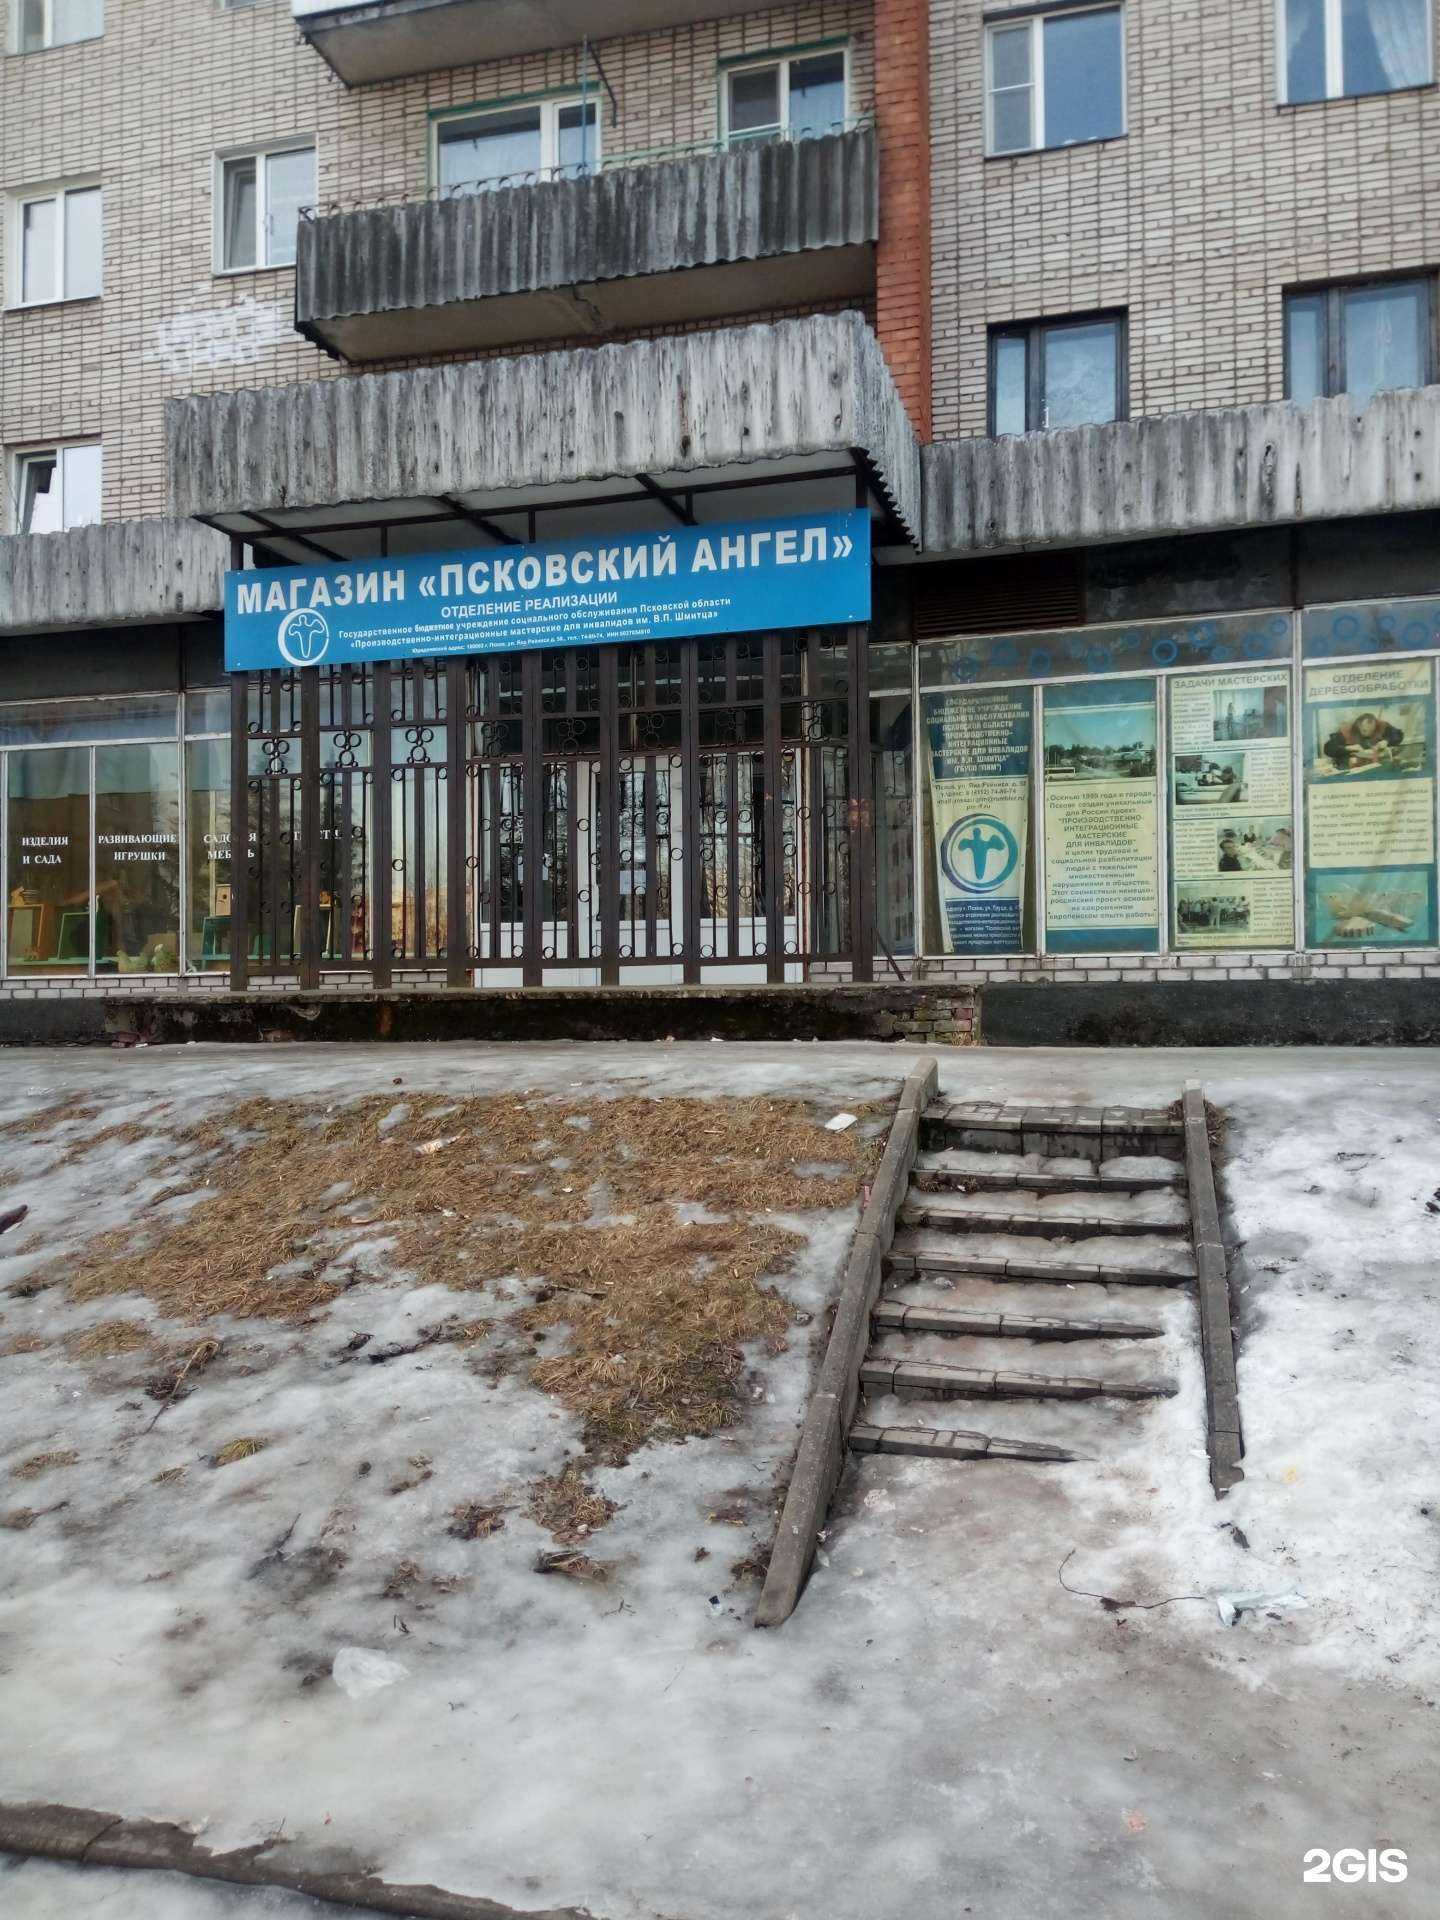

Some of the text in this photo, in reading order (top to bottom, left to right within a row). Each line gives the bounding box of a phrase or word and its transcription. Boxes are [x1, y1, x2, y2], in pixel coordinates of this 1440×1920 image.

[237, 526, 853, 615] МАГАЗИН «ПСКОВСКИЙ АНГЕЛ»
[441, 591, 618, 619] ОТДЕЛЕНИЕ РЕАЛИЗАЦИИ
[338, 597, 731, 640] Государственное бюджетное учреждение социального обслуживания Псковской области
[350, 610, 718, 649] «Производственно-интеграционные мастерские для инвалидов им. В.П. Шмитца»
[1174, 673, 1288, 689] ЗАДАЧИ МАСТЕРСКИХ
[1332, 669, 1403, 683] ОТДЕЛЕНИЕ
[1309, 679, 1429, 697] ДЕРЕВООБРАБОТКИ
[983, 720, 1014, 729] ОБЛАСТИ
[1063, 822, 1138, 832] ИНТЕГРАЦИОННЫЕ
[22, 836, 69, 847] ИЗДЕЛИЯ
[98, 833, 177, 845] РАЗВИВАЮЩИЕ
[1075, 831, 1127, 839] МАСТЕРСКИЕ
[22, 854, 62, 865] И САДА
[113, 850, 165, 862] ИГРУШКИ
